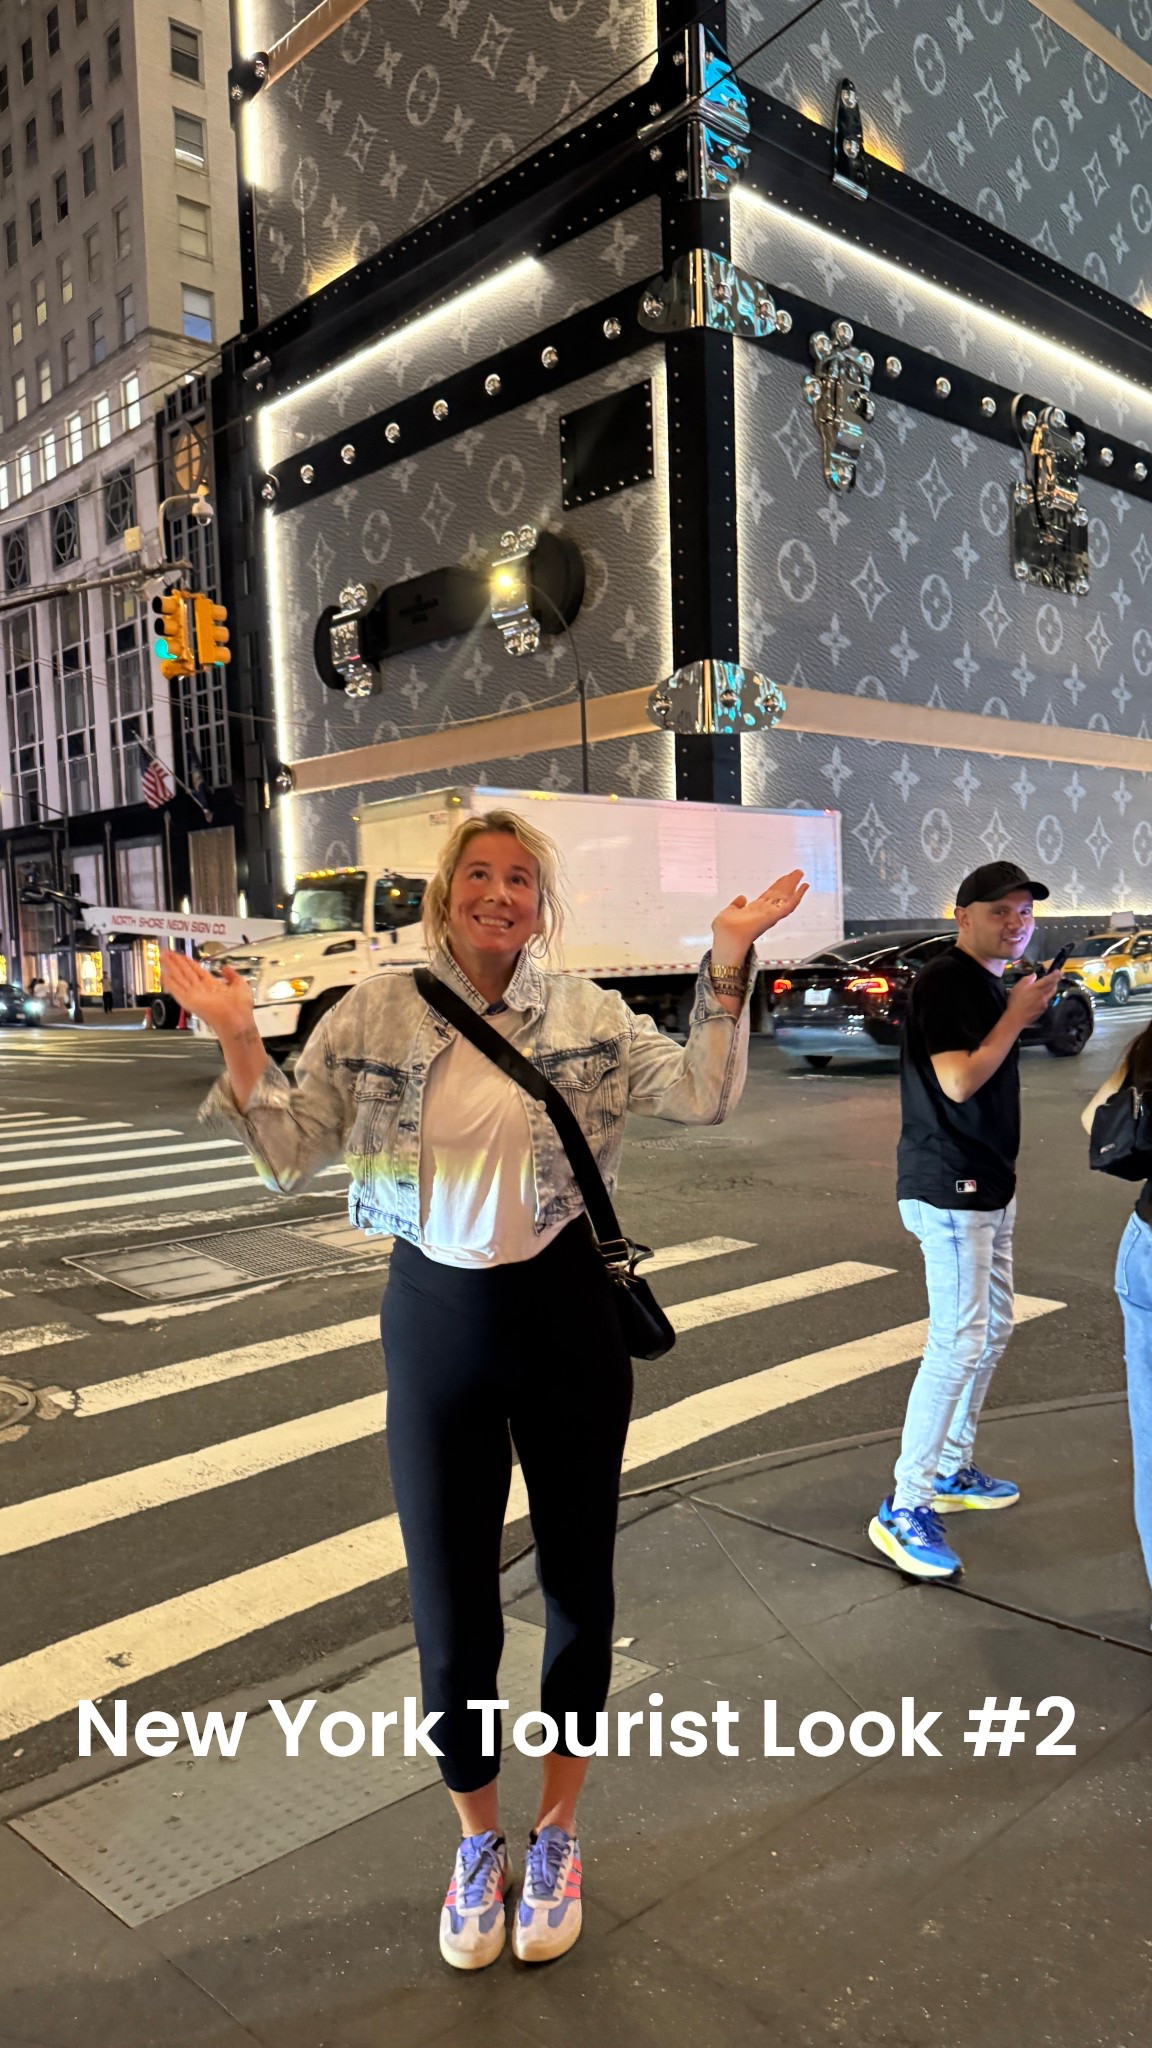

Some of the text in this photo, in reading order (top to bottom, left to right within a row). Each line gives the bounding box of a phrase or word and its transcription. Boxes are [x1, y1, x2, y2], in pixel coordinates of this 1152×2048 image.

[111, 915, 227, 935] NORTH SHORE NEON SIGN CO.
